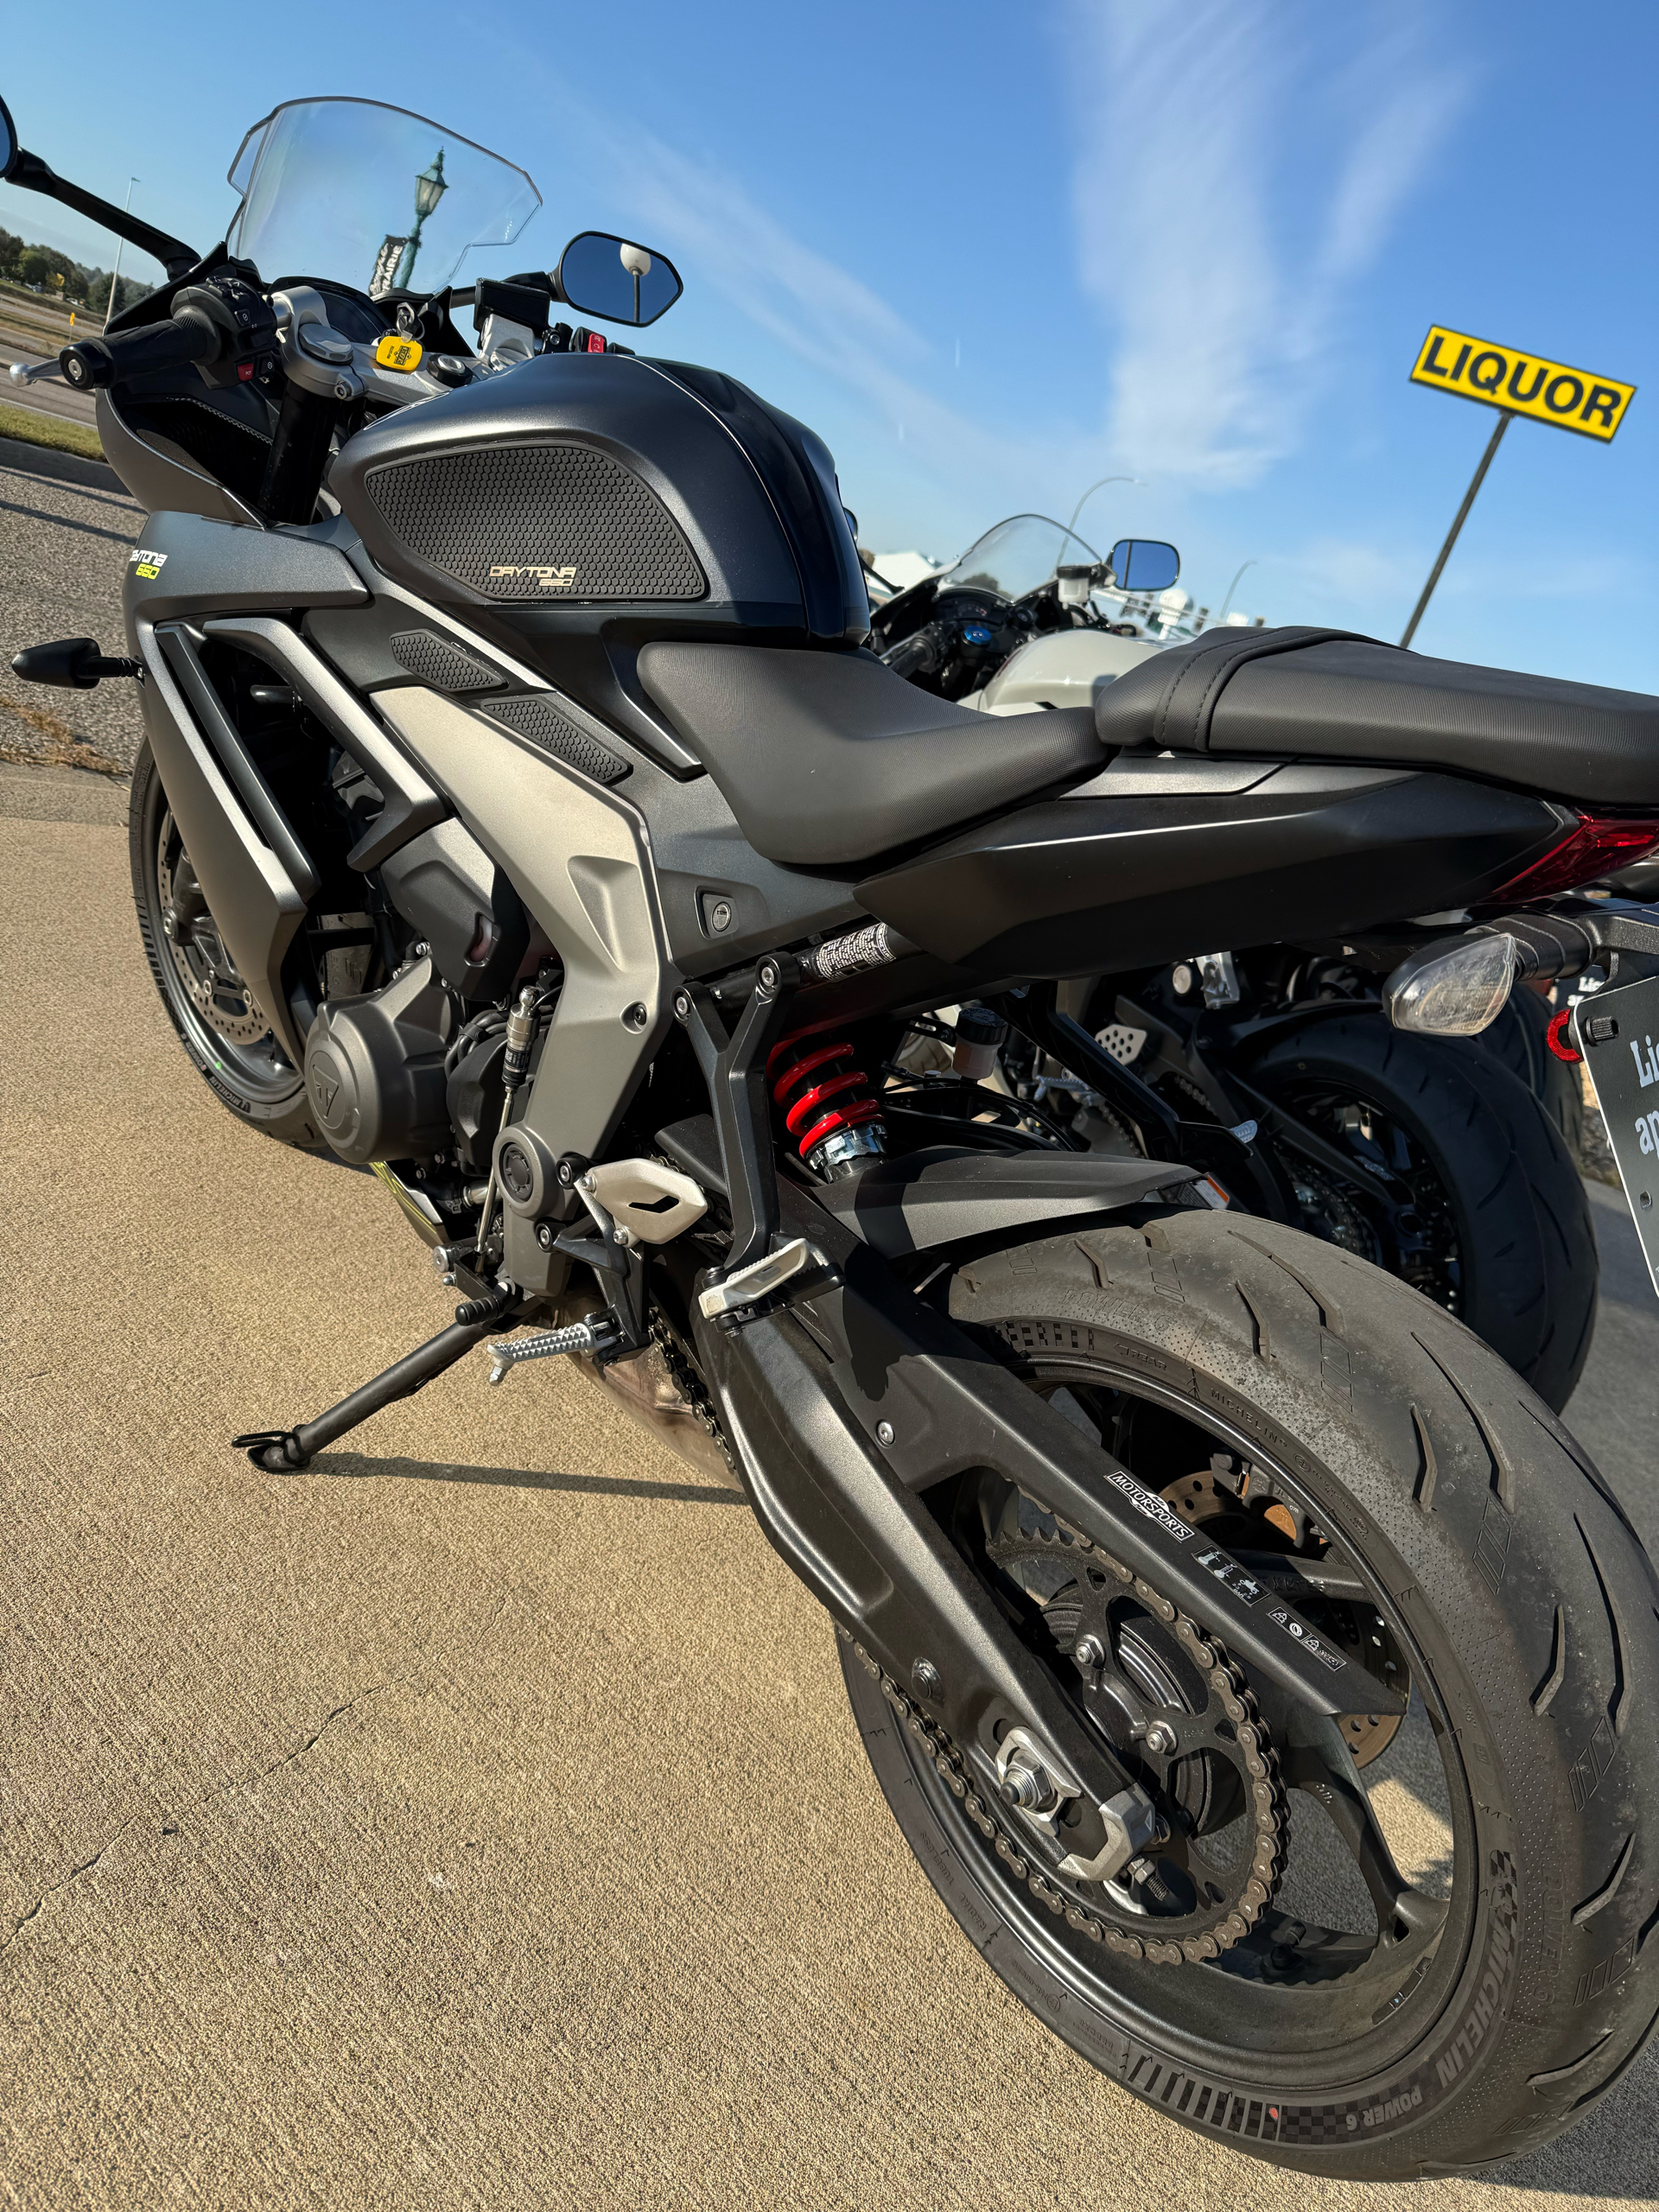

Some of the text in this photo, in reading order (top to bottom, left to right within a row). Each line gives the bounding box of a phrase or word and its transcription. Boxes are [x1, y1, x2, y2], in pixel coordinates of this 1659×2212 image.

[1421, 335, 1622, 429] LIQUOR
[136, 563, 160, 580] 660
[489, 566, 577, 578] DAYTONA
[186, 1041, 207, 1071] POWER
[209, 1076, 242, 1106] MICHELIN
[1211, 1388, 1278, 1443] MICHELIN
[1112, 1475, 1189, 1537] MOTORSPORTS
[920, 1830, 987, 1931] RADIAL TUBELESS
[1345, 1916, 1511, 2131] MICHELIN POWER 6
